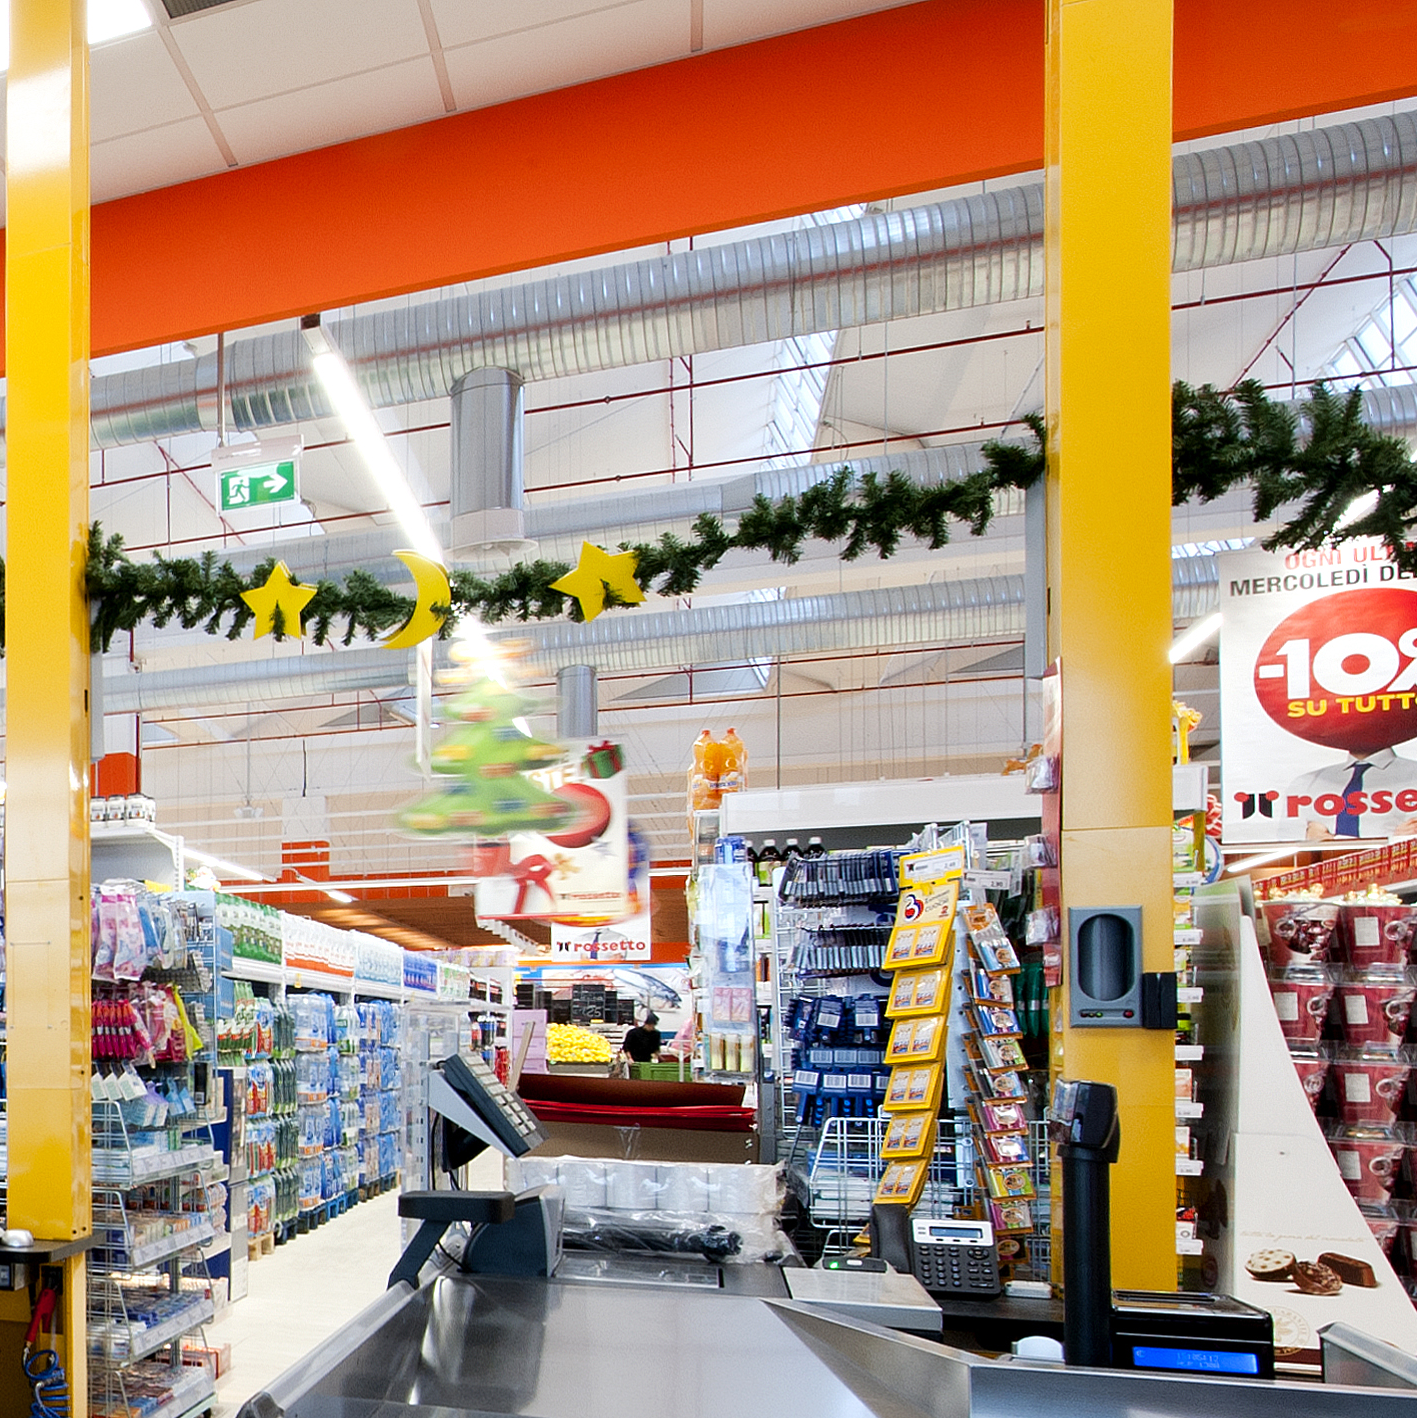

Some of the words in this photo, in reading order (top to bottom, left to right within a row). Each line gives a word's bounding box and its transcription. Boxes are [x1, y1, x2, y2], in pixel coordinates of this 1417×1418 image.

[1230, 564, 1368, 597] MERCOLEDÌ
[1287, 699, 1327, 718] SU
[1335, 692, 1417, 714] TUTT
[1287, 789, 1417, 817] rosse
[573, 940, 646, 952] rossetto
